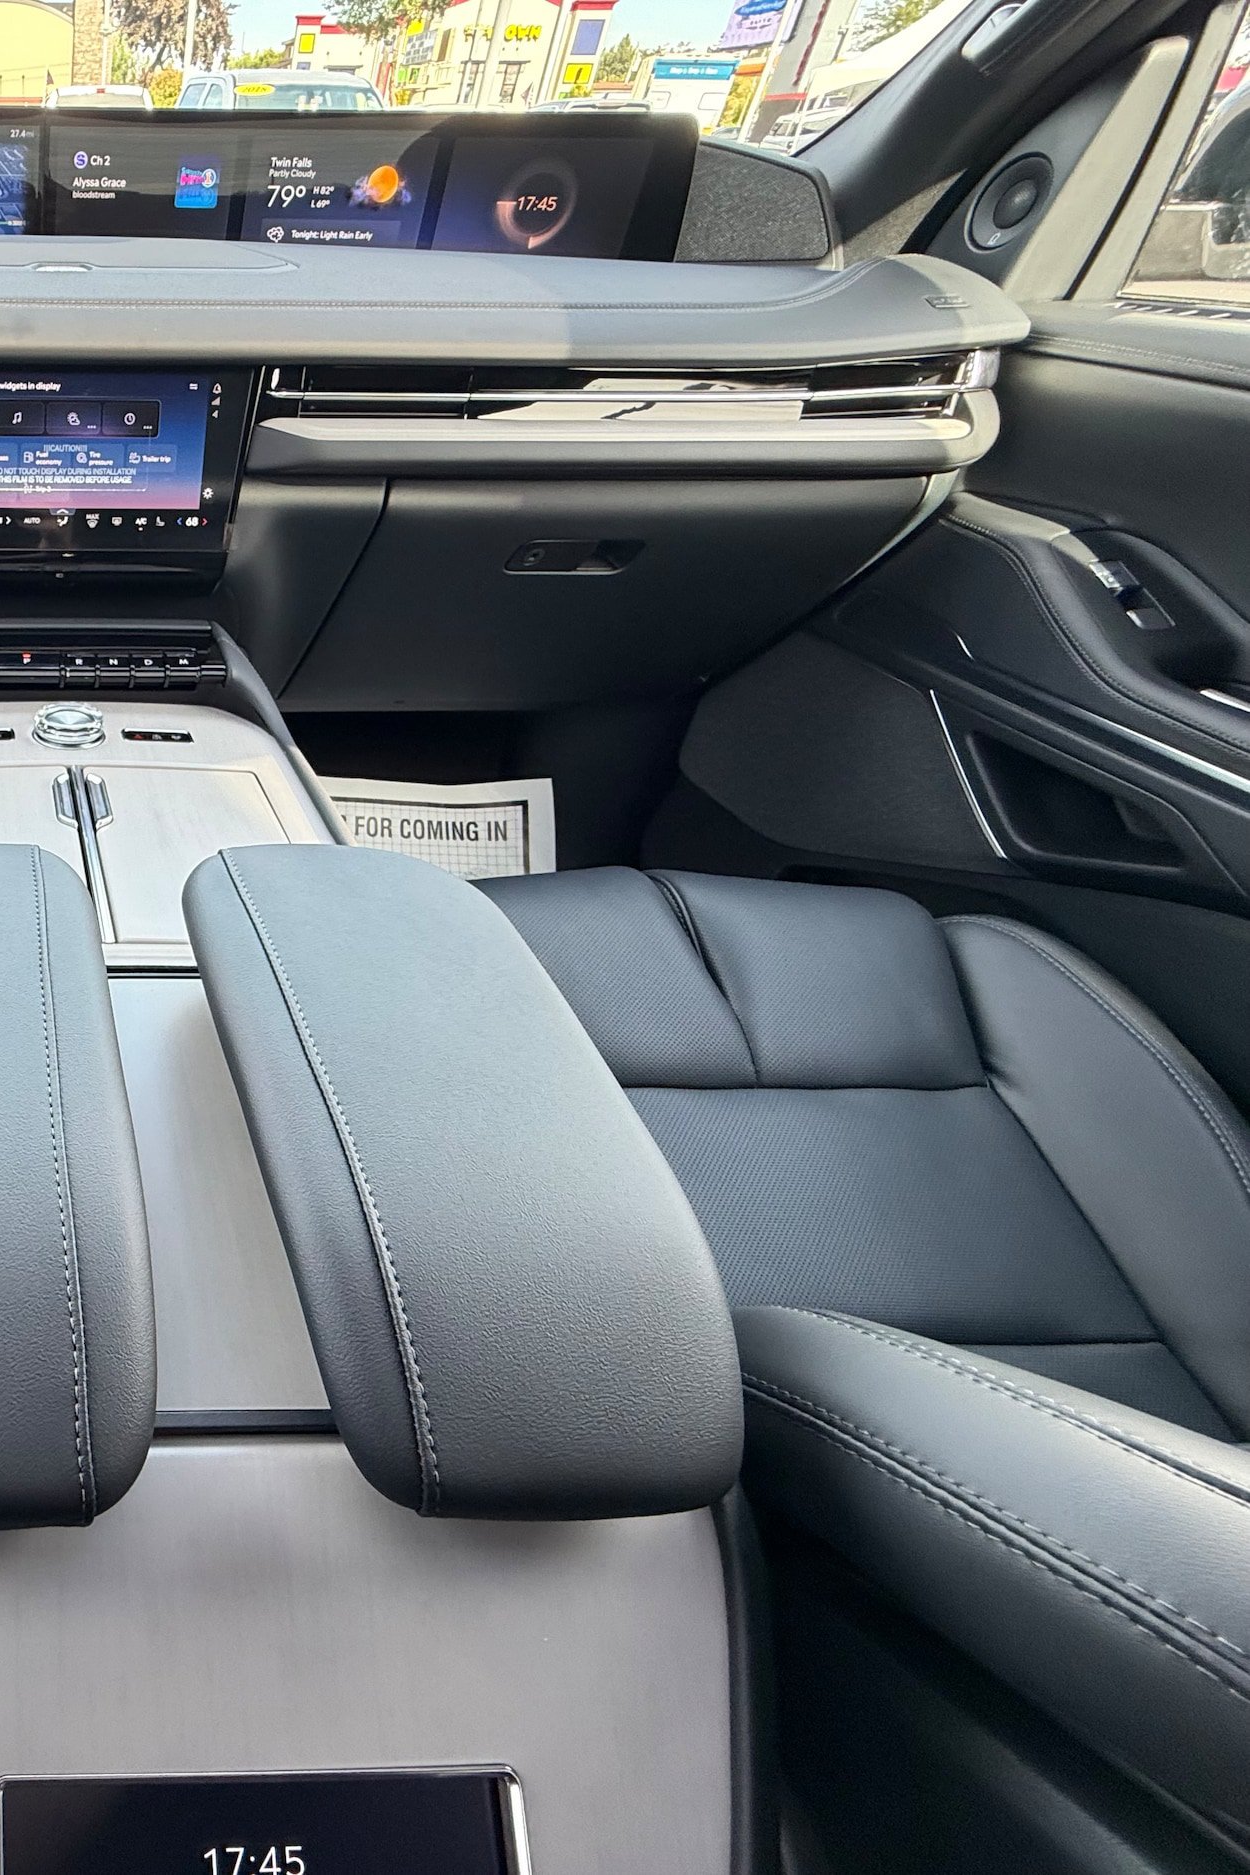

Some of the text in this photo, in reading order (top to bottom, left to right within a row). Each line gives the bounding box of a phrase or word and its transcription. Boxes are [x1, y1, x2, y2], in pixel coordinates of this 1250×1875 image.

[90, 155, 103, 166] Ch
[104, 155, 111, 166] 2
[270, 157, 312, 168] Twin Falls
[269, 169, 316, 179] Partly Cloudy
[72, 177, 126, 189] Alyssa Grace
[72, 190, 116, 199] bloodstream
[312, 186, 319, 195] H
[310, 200, 316, 208] L
[517, 196, 558, 211] 17:45
[291, 229, 374, 241] Tonight: Light Rain Early
[0, 381, 27, 391] widgets
[28, 381, 35, 390] in
[35, 382, 61, 391] display
[4, 467, 17, 476] NOT
[18, 467, 41, 476] TOUCH
[41, 467, 67, 476] DISPLAY
[67, 467, 91, 476] DURING
[92, 467, 137, 476] INSTALLATION
[12, 475, 28, 484] FILM
[53, 475, 85, 484] REMOVED
[85, 475, 110, 484] BEFORE
[23, 517, 41, 525] AUTO
[185, 516, 199, 526] 68
[354, 816, 508, 842] FOR COMING IN
[203, 1845, 305, 1875] 17:45
